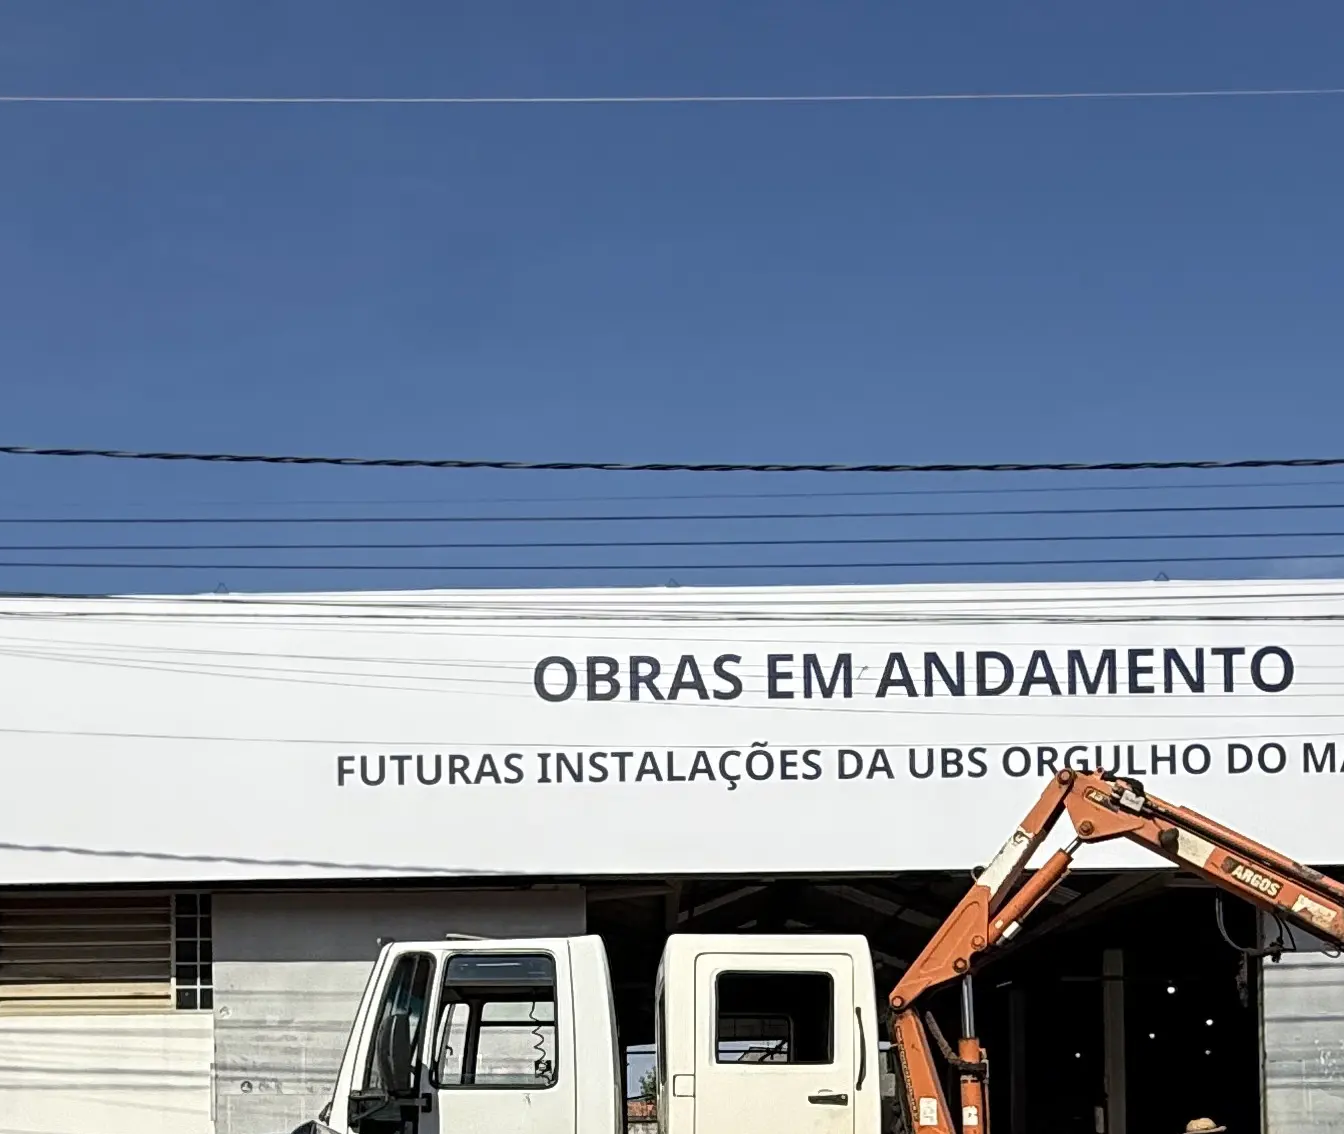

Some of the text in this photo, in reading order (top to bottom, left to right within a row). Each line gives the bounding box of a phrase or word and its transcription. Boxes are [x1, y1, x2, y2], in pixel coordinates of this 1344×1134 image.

[533, 646, 1295, 702] OBRAS EM ANDAMENTO
[337, 753, 524, 786] FUTURAS
[537, 741, 822, 791] INSTALAÇÕES
[838, 748, 895, 780] DA
[909, 747, 988, 779] UBS
[1002, 743, 1211, 778] ORGULHO
[1227, 742, 1287, 774] DO
[1231, 863, 1282, 897] ARGOS
